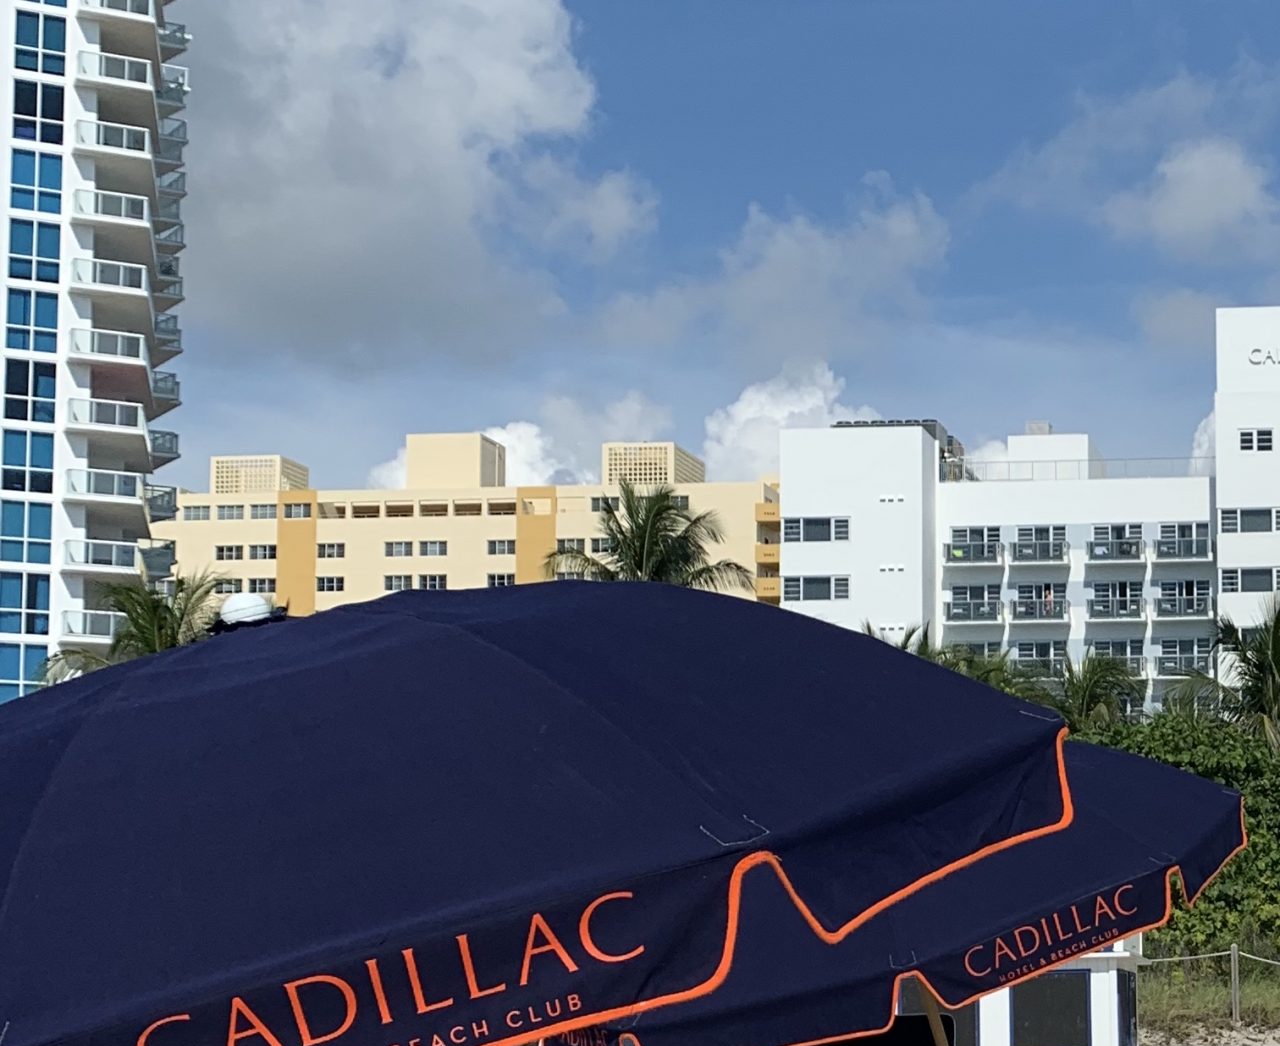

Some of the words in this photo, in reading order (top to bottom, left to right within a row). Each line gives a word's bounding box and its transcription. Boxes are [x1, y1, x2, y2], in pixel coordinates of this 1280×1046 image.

[963, 885, 1138, 976] CADILLAC
[998, 963, 1035, 982] HOTEL
[1050, 940, 1087, 961] BEACH
[1091, 927, 1120, 944] CLUB
[505, 993, 584, 1029] CLUB
